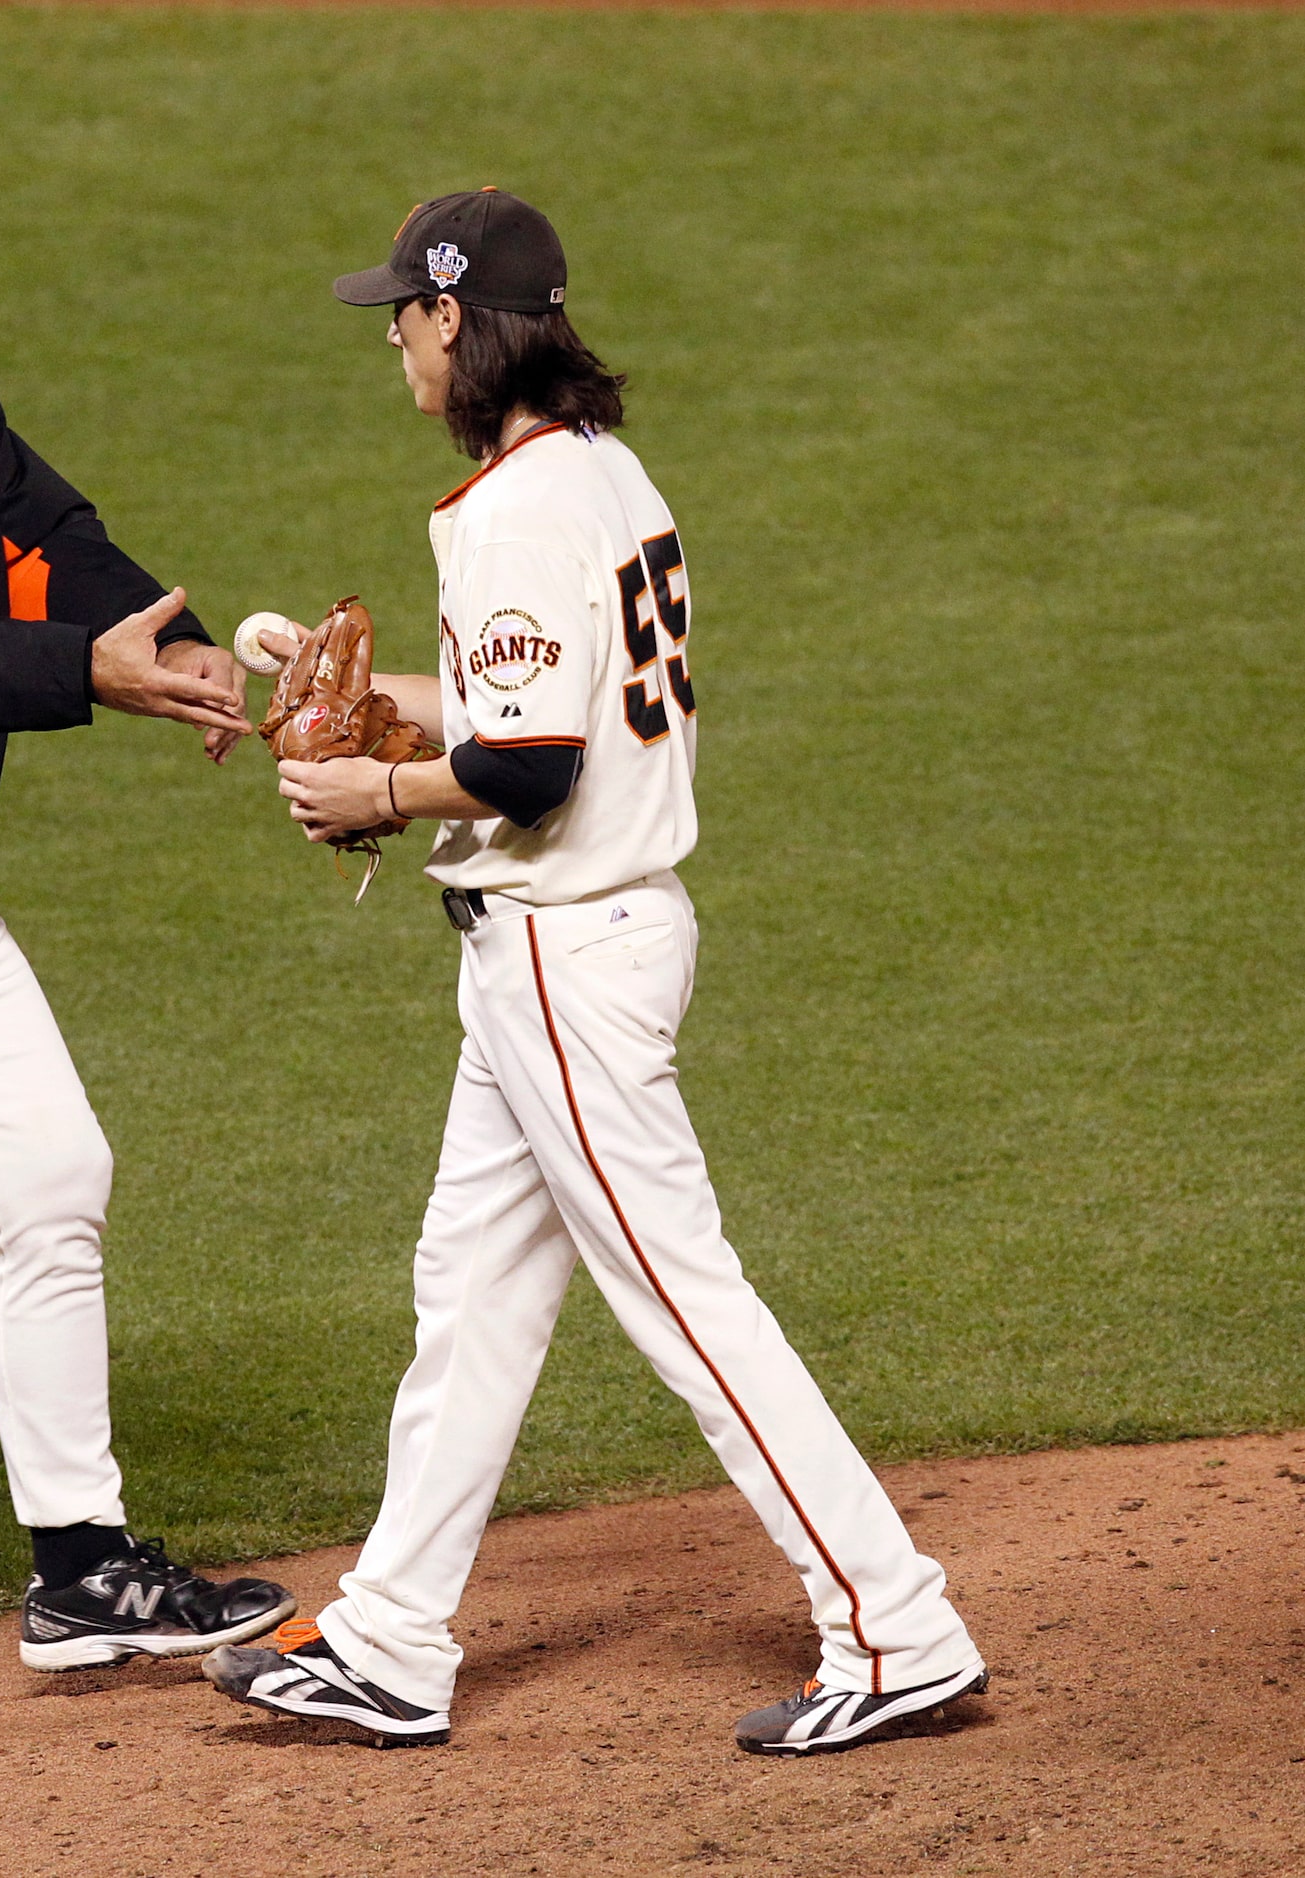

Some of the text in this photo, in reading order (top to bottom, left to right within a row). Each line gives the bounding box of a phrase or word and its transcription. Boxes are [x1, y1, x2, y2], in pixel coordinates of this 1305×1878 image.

[429, 249, 466, 268] WORLD
[479, 608, 542, 639] SAN FRANCISCO
[615, 528, 697, 747] 55
[317, 660, 334, 681] 55
[469, 635, 562, 675] GIANTS
[483, 666, 542, 692] BASEBALL CLUB
[113, 1581, 165, 1619] N
